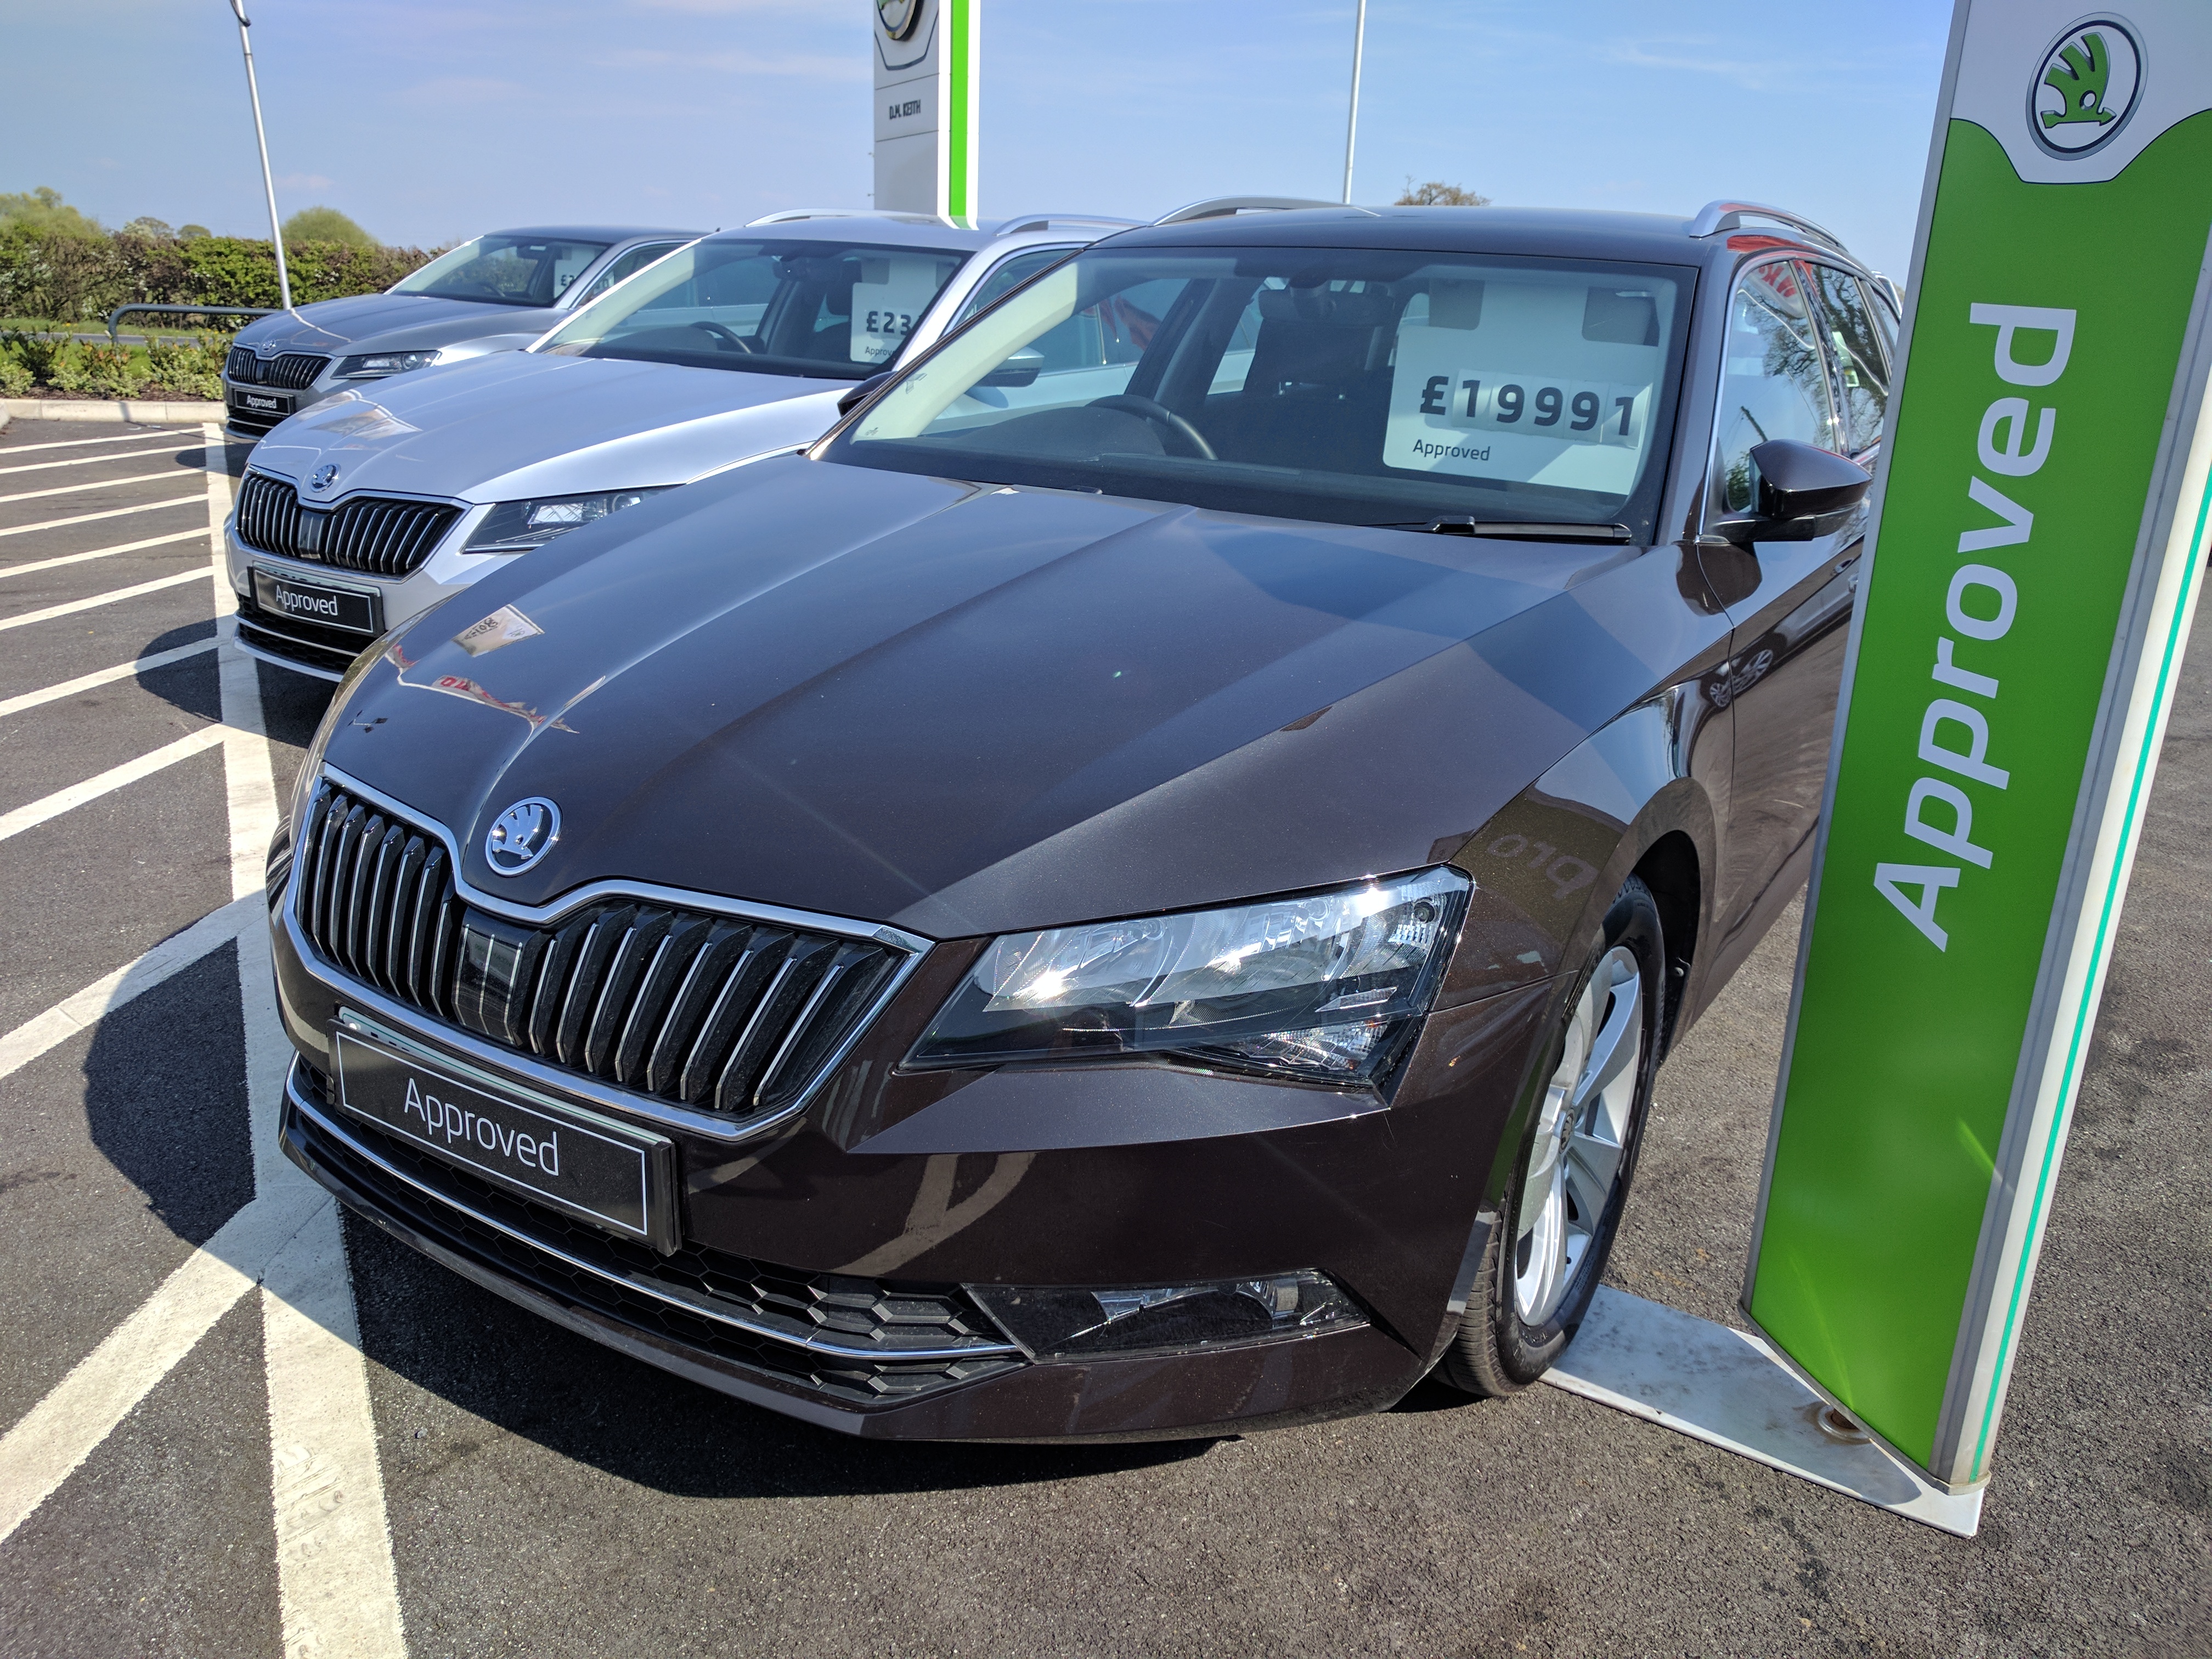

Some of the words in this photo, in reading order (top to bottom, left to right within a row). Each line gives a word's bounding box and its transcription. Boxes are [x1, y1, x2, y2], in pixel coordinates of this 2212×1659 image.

[889, 104, 901, 120] D.M.
[903, 99, 921, 117] KEITH
[866, 311, 912, 336] £23
[865, 346, 894, 357] Approv
[246, 394, 277, 409] Approved
[1419, 375, 1635, 436] £19991
[1413, 439, 1491, 461] Approved
[275, 584, 338, 617] Approved
[1874, 302, 2076, 953] Approved
[404, 1077, 560, 1177] Approved
